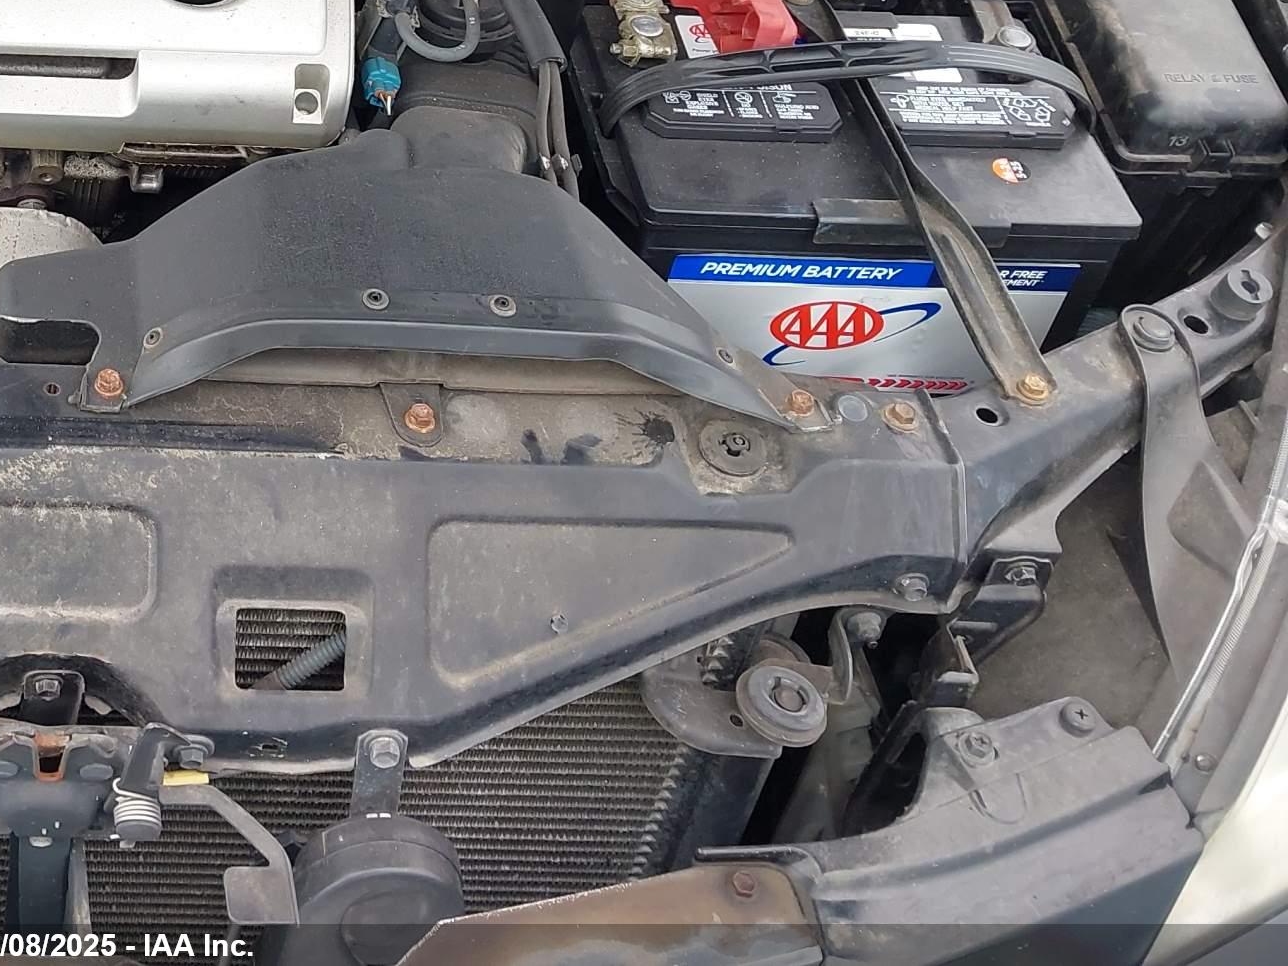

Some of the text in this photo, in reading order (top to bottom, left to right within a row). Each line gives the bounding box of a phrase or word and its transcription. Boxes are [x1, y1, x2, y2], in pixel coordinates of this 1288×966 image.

[1163, 73, 1206, 83] RELAY
[1223, 74, 1260, 84] FUSE
[1168, 135, 1190, 147] 13
[700, 261, 904, 281] PREMIUM BATTERY
[1009, 270, 1049, 279] FREE
[769, 300, 887, 351] AAA
